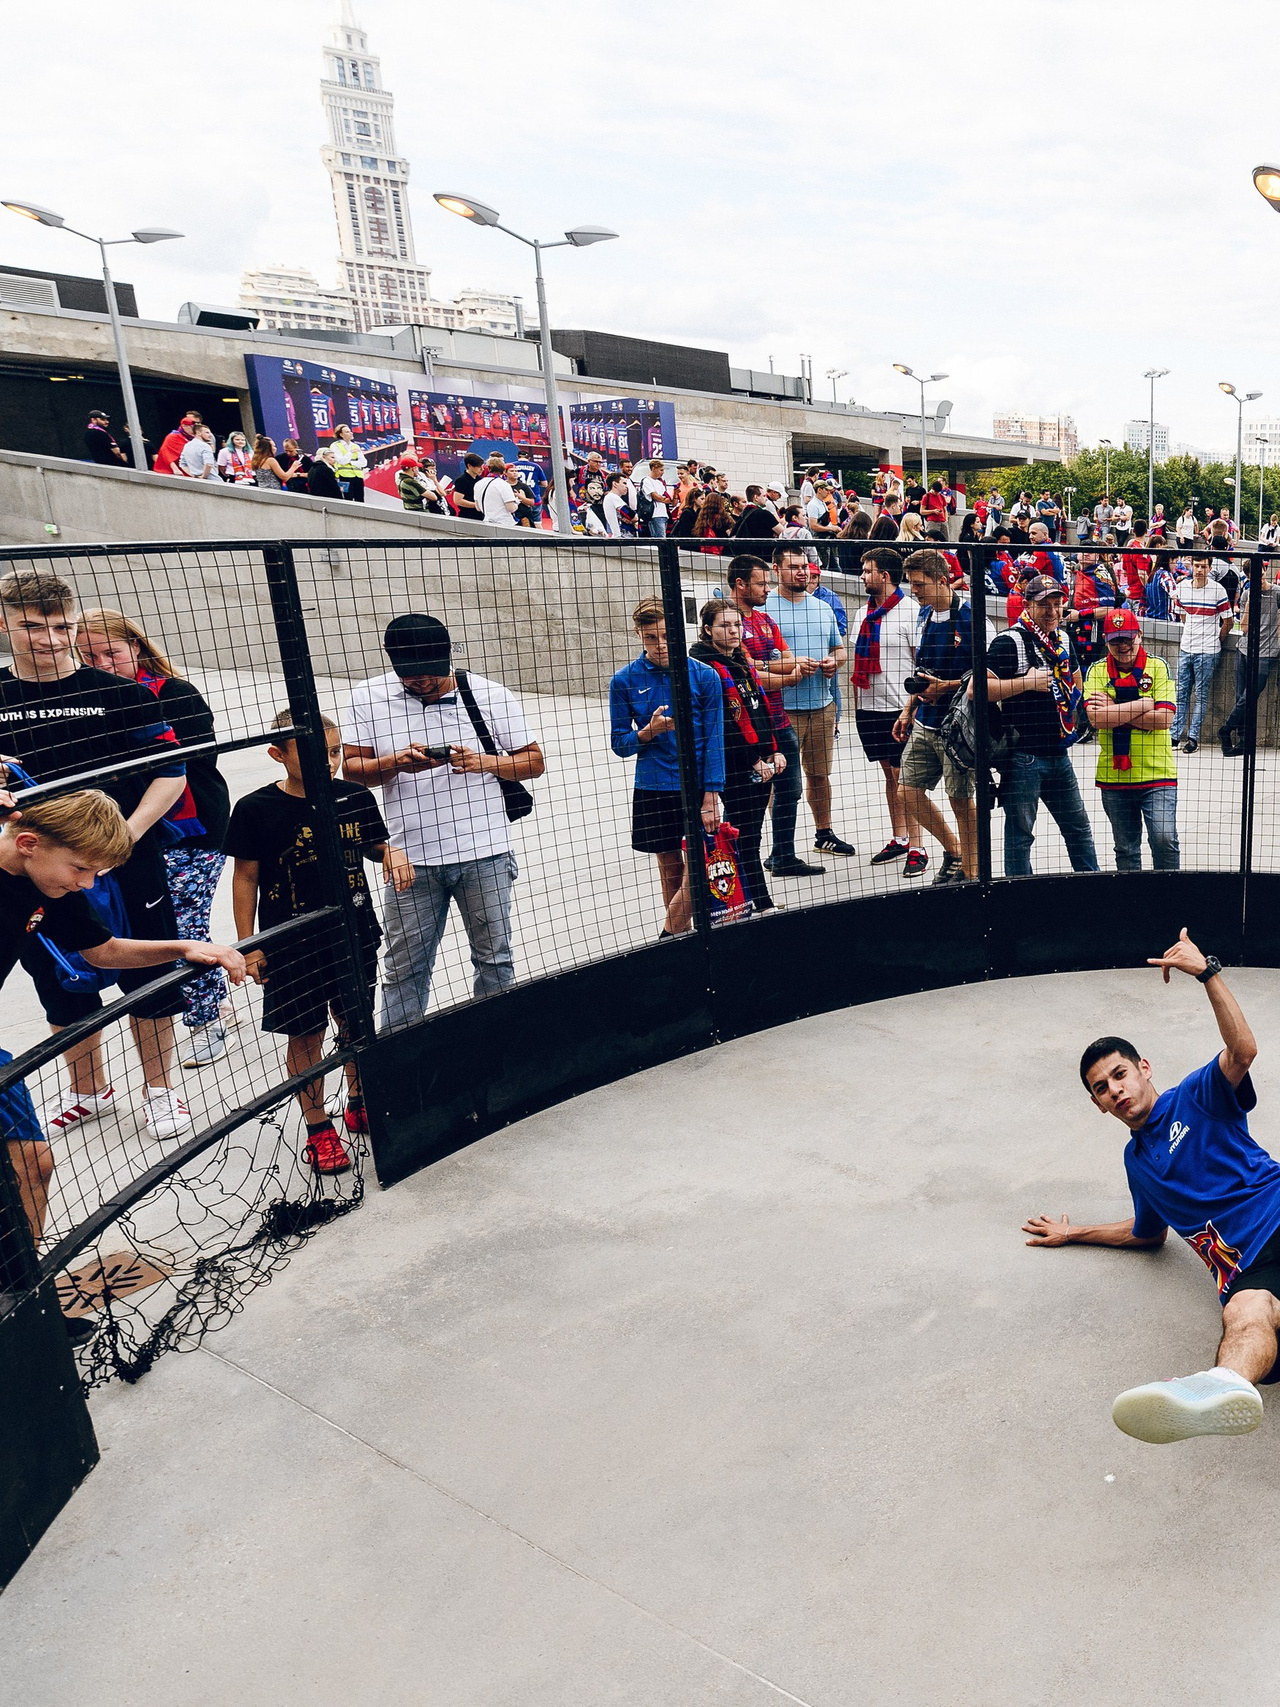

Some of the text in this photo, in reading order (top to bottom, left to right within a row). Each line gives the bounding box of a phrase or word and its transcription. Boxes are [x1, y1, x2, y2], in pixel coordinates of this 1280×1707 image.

[0, 707, 105, 722] UTH IS EXPENSIVE
[1169, 1124, 1190, 1154] HYUNDAI
